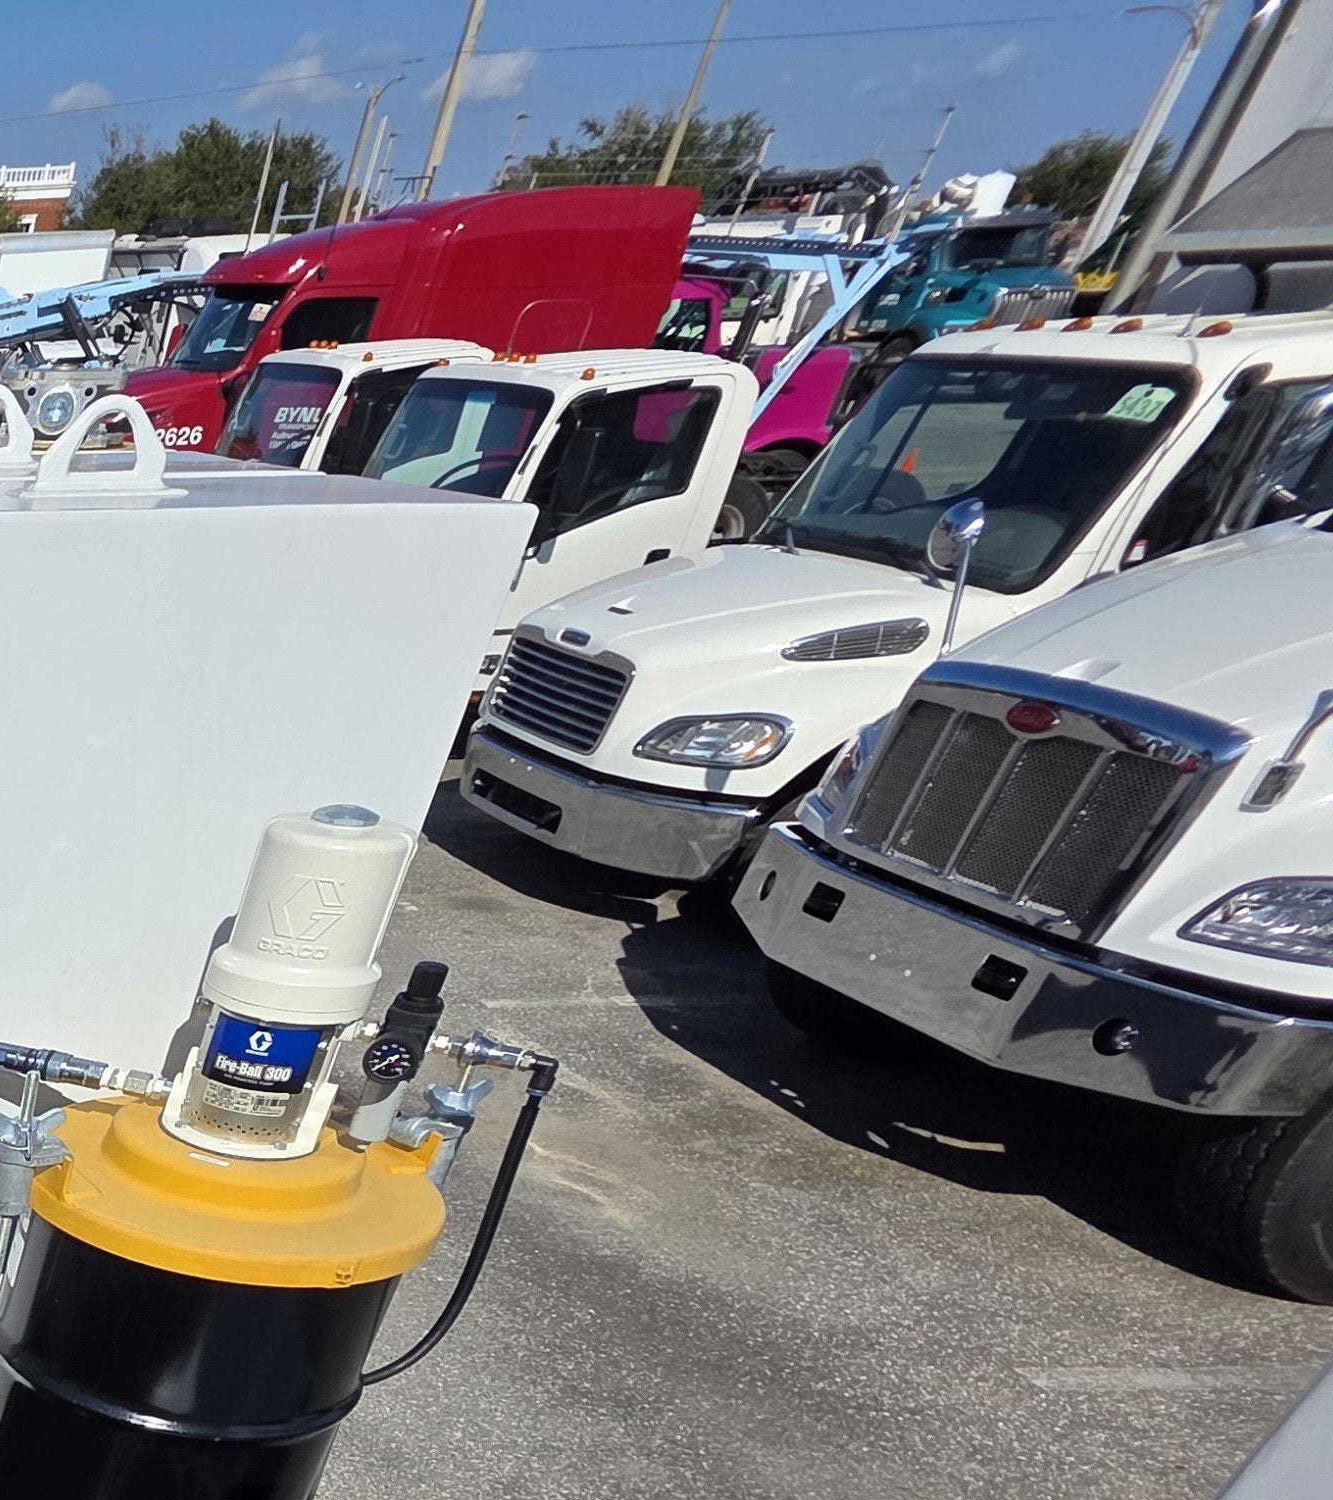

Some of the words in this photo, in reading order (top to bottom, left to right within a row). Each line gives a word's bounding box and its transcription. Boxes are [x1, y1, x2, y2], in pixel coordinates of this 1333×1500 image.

[257, 936, 330, 960] GRACO
[215, 1053, 263, 1080] Fire-Ball
[263, 1066, 294, 1082] 300
